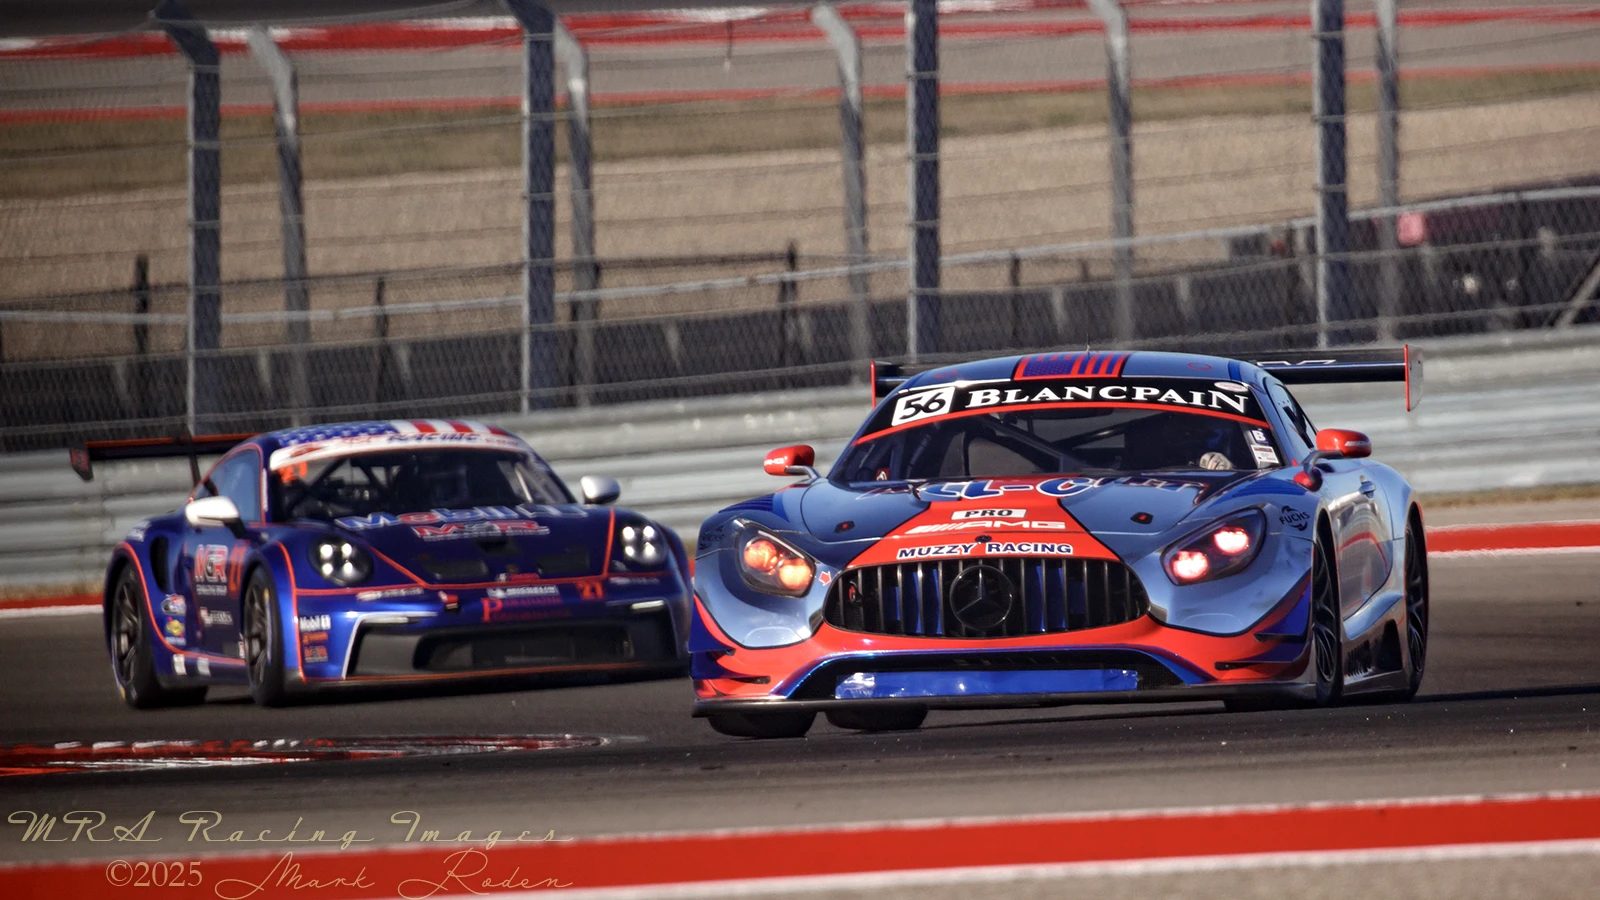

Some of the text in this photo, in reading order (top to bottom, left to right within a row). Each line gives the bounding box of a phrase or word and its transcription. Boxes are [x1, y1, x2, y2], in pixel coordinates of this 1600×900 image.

[899, 385, 1248, 420] 56 BLANCPAIN
[1252, 430, 1267, 442] B
[335, 506, 519, 532] Mobil
[965, 508, 1015, 519] PRO
[1279, 510, 1310, 525] FUCHS
[959, 520, 1065, 531] AMG
[898, 542, 1073, 558] MUZZY RACING
